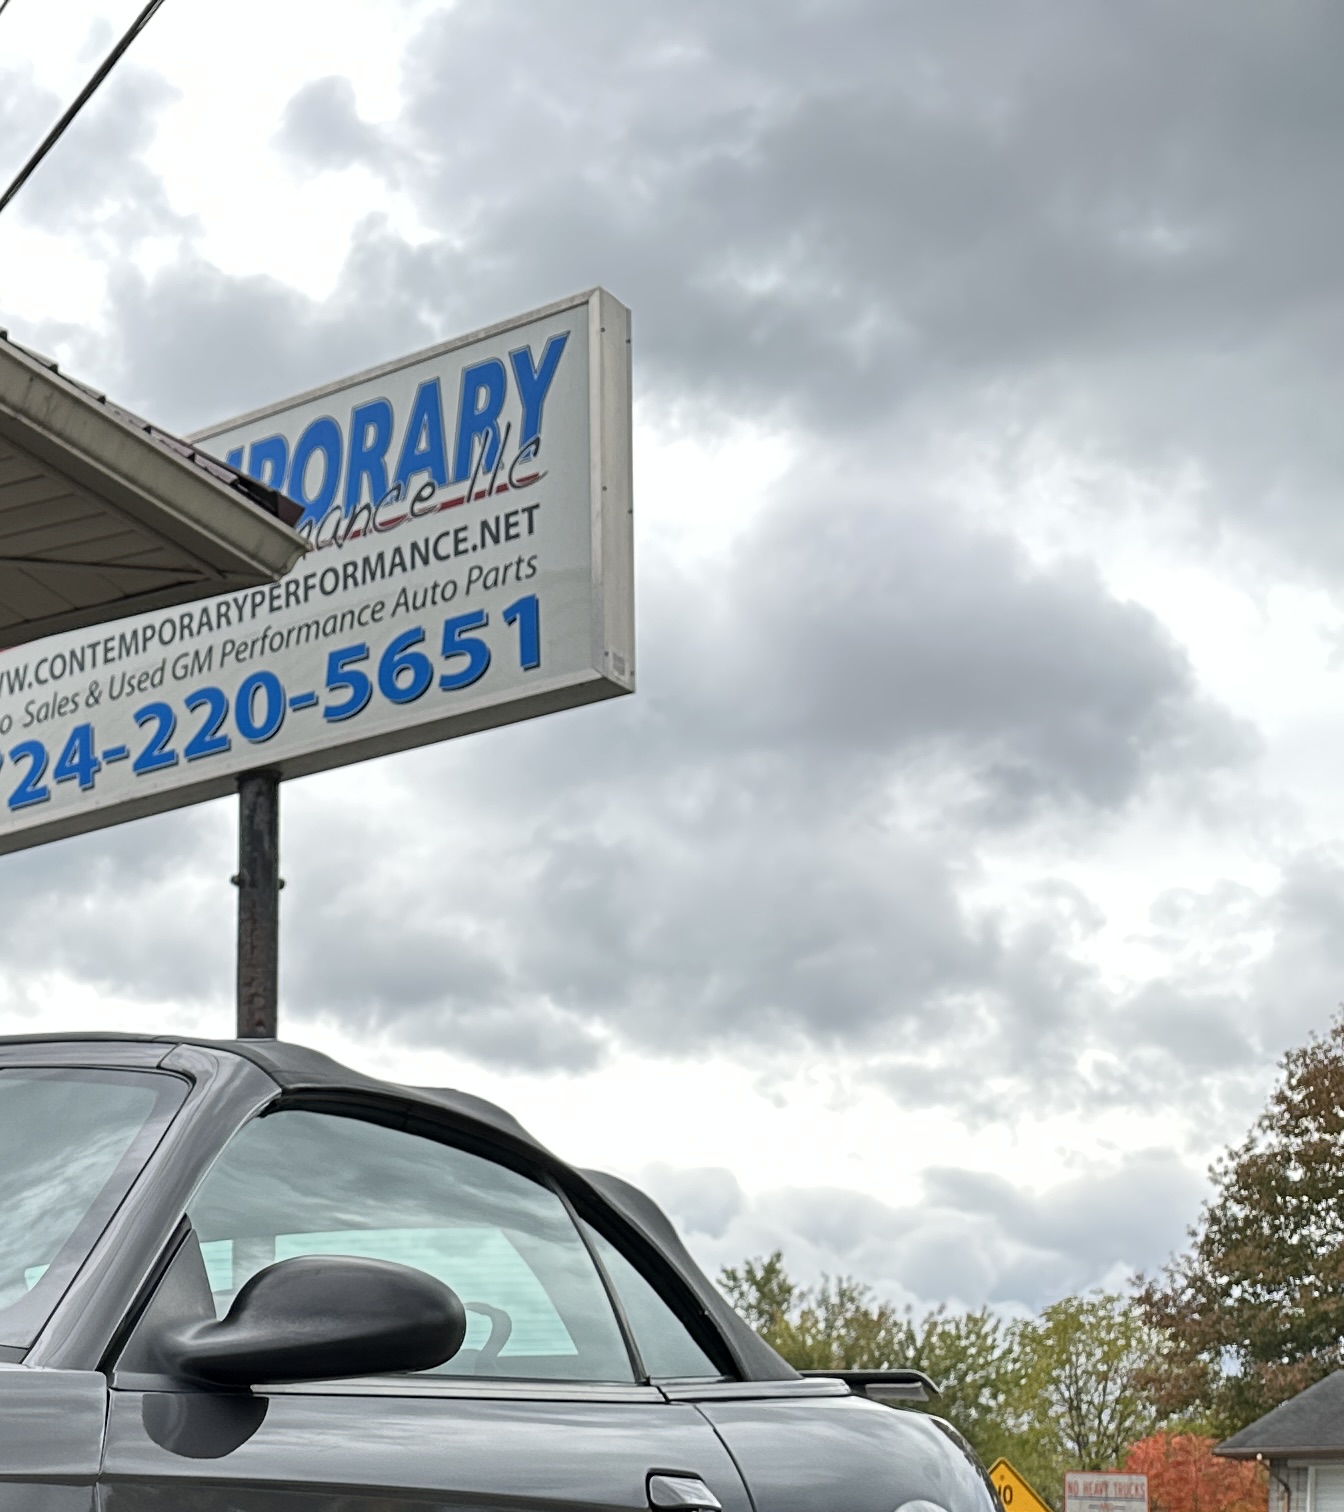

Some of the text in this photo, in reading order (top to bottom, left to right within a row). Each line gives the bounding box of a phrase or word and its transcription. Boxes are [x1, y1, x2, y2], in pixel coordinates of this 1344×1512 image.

[226, 330, 570, 528] PORARY
[22, 690, 80, 729] Sales
[85, 680, 103, 708] &
[108, 657, 167, 701] Used
[171, 645, 214, 682] GM
[219, 600, 386, 668] Performance
[391, 579, 457, 618] Auto
[465, 554, 539, 596] Parts
[1067, 1480, 1146, 1498] NO HEAVY TRUCKS
